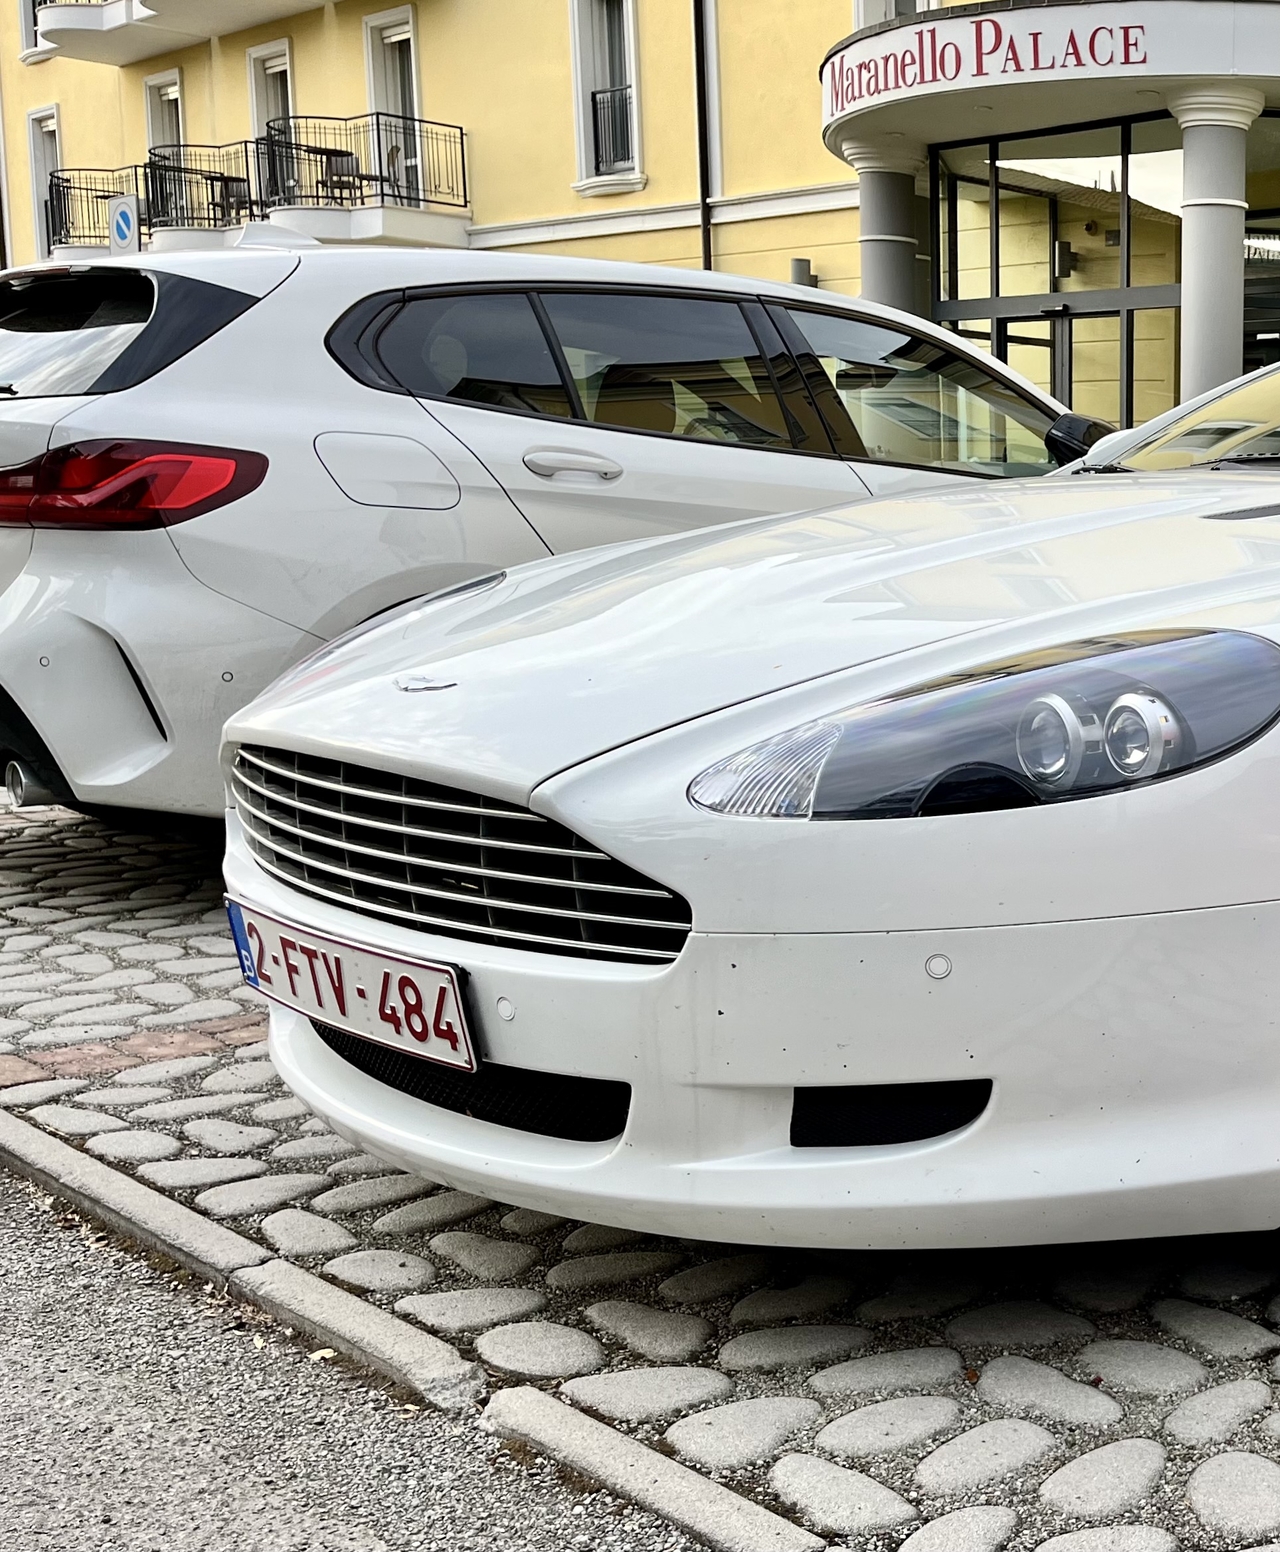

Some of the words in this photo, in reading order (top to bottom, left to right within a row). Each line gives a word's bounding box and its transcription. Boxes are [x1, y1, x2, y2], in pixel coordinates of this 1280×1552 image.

[830, 27, 961, 117] Maranello
[970, 18, 1147, 77] PALACE
[241, 949, 255, 977] B
